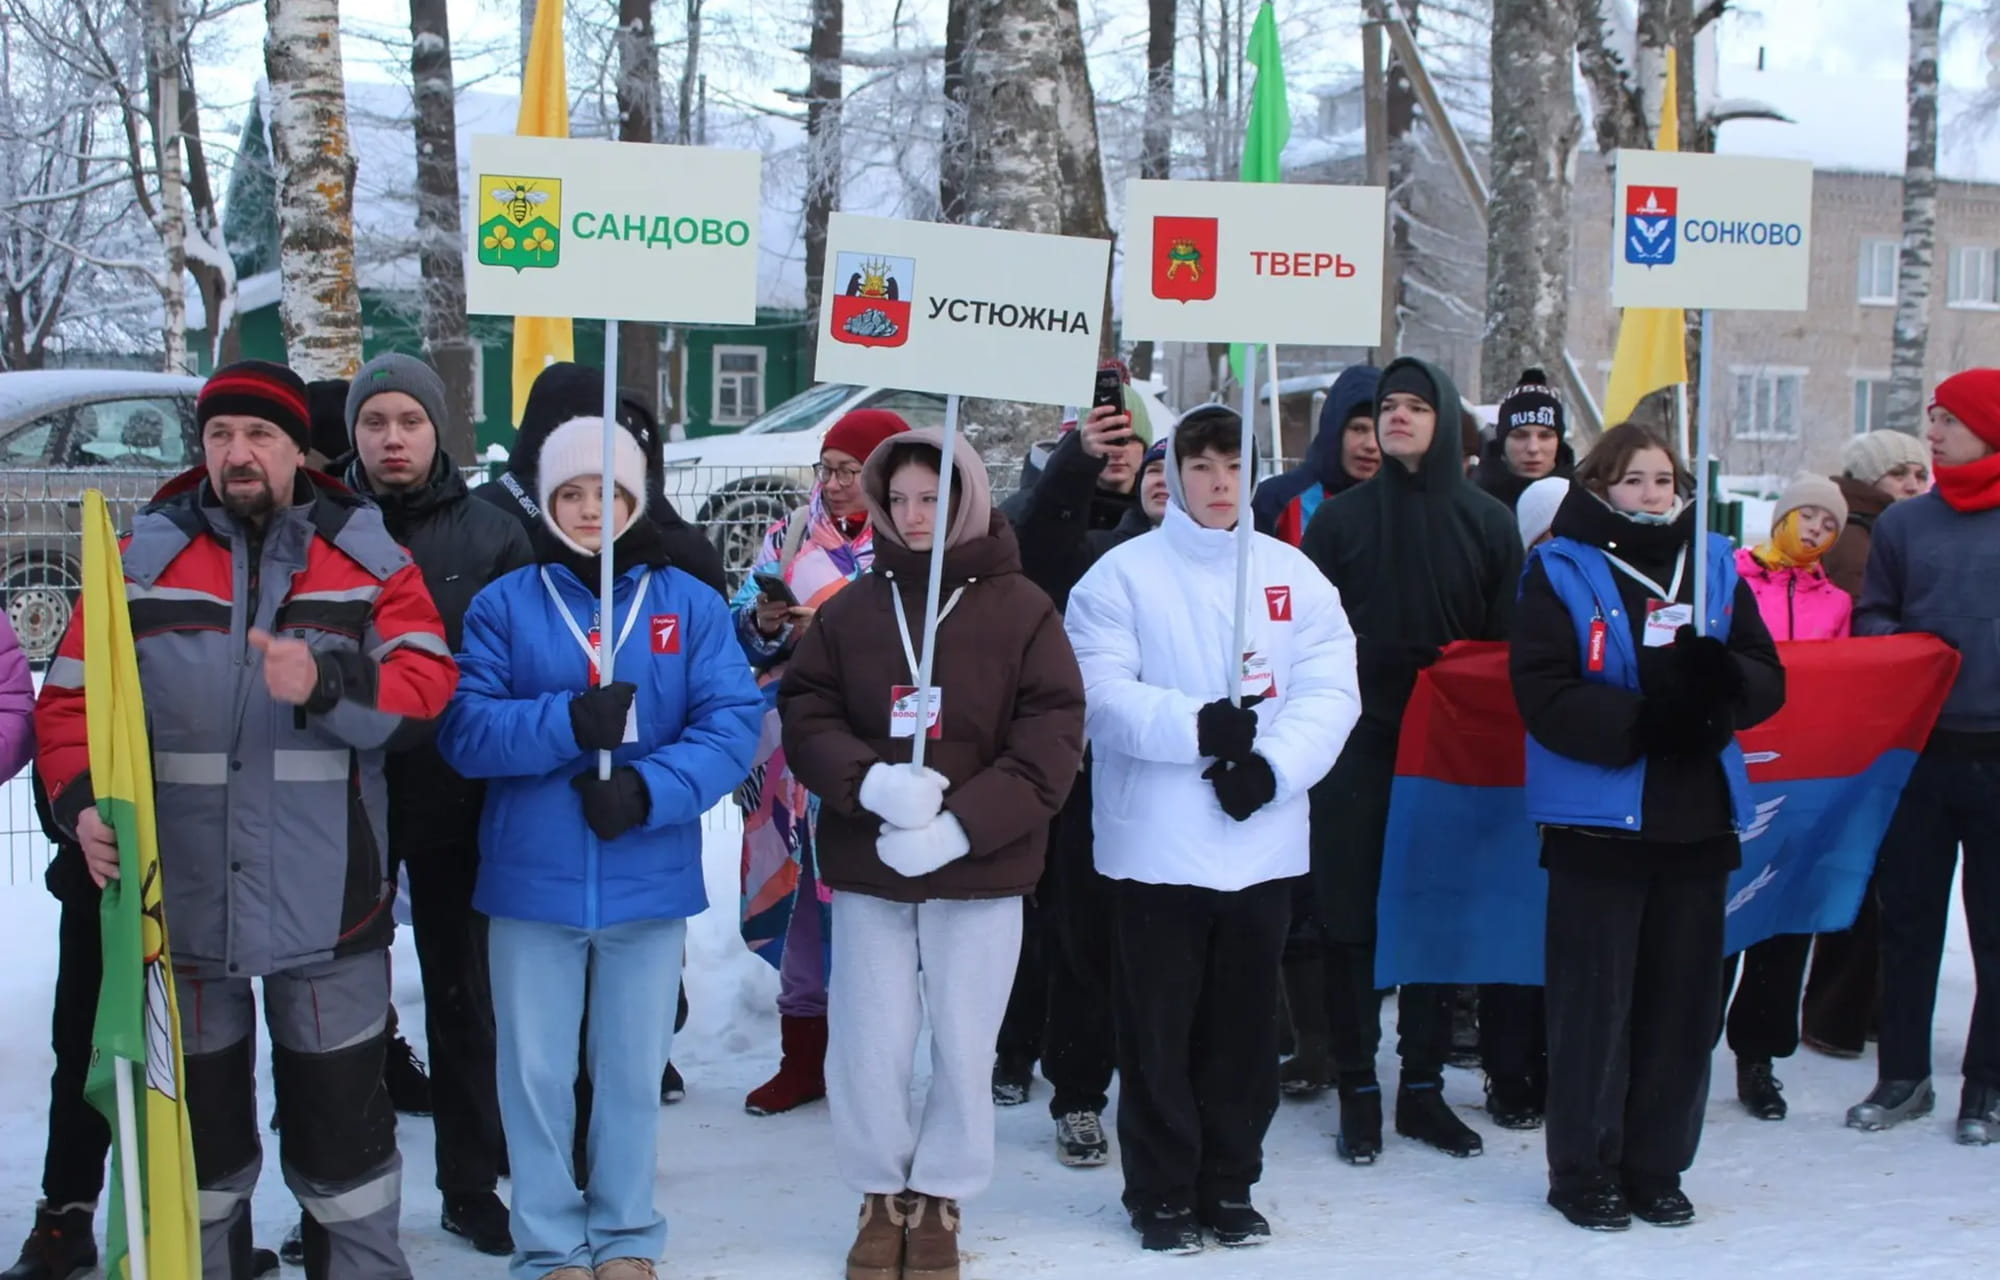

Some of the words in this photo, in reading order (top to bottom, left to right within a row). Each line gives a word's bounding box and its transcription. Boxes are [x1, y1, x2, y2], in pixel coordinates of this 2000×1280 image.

[571, 211, 750, 250] САНДОВО
[1684, 219, 1802, 246] СОНКОВО
[1249, 251, 1356, 278] ТВЕРЬ
[928, 296, 1090, 335] УСТЮЖНА
[1510, 410, 1555, 427] RUSSIA
